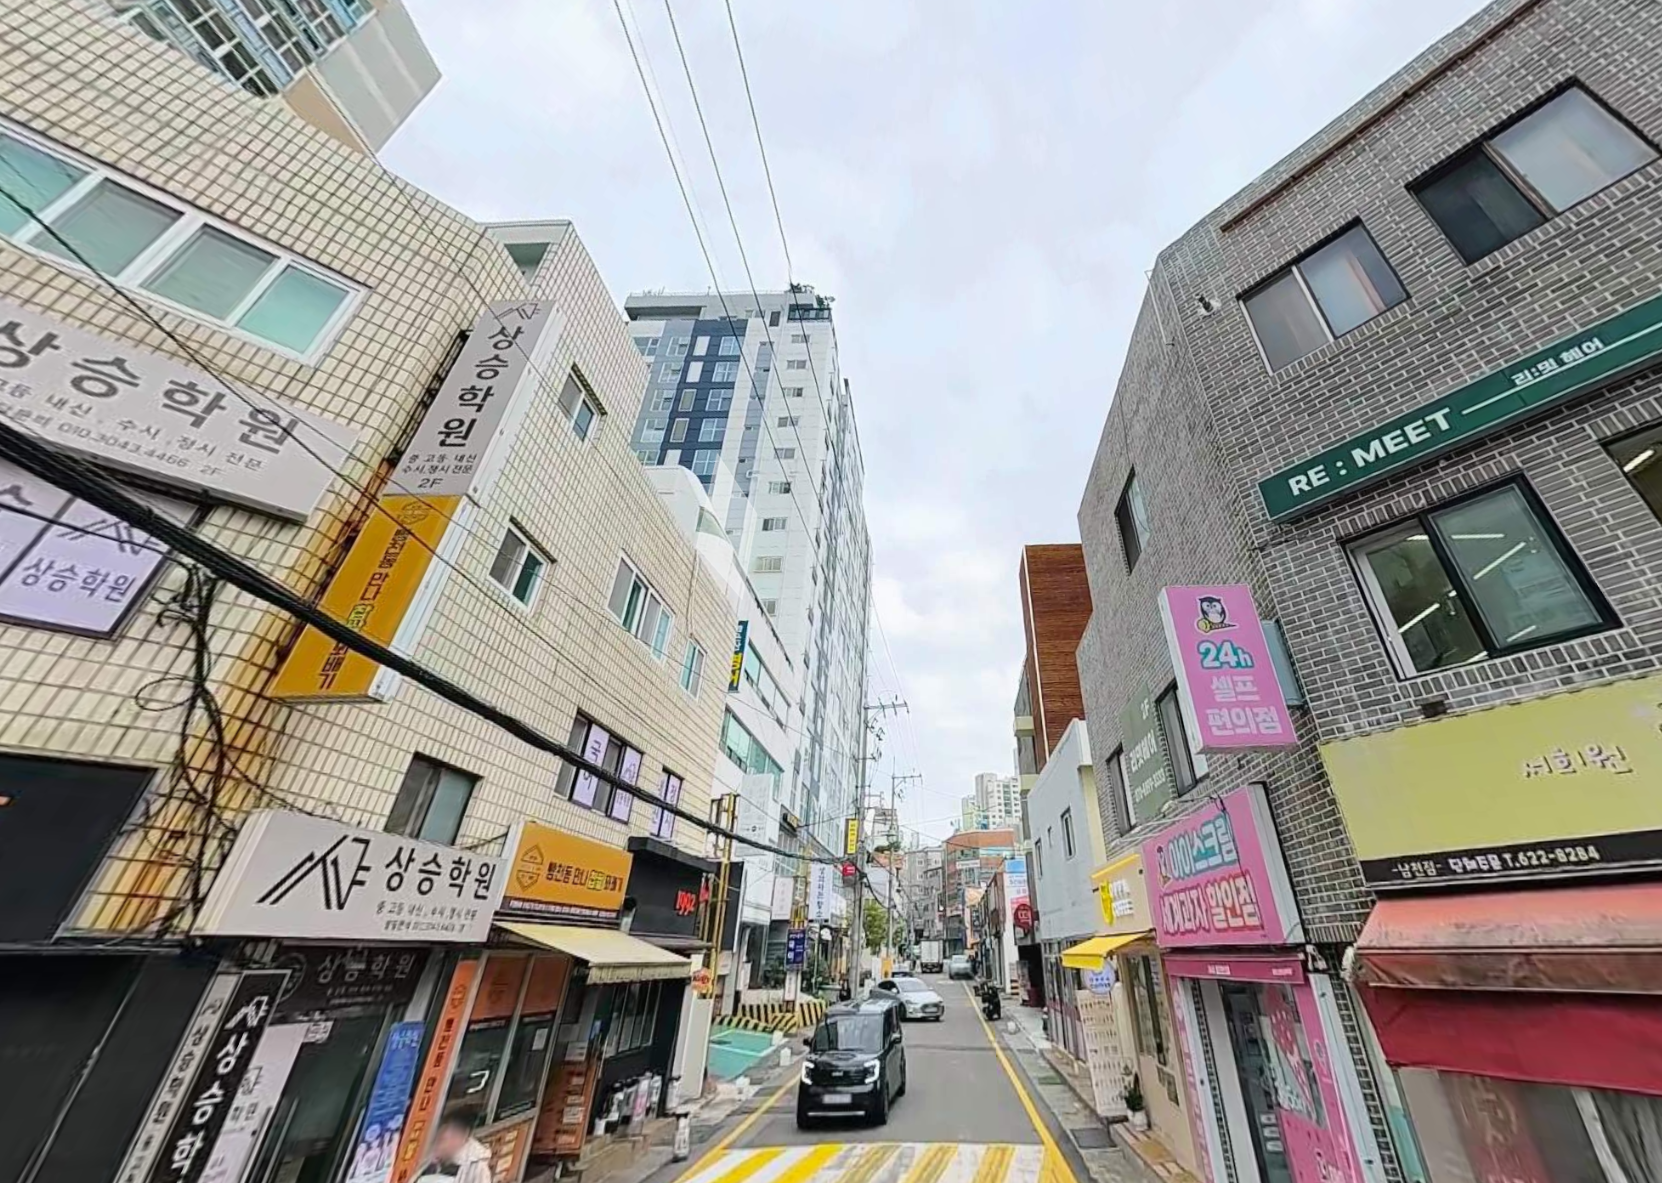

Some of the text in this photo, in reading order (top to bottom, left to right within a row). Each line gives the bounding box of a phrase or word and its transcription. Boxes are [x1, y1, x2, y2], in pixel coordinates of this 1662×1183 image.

[1559, 337, 1607, 363] 헤어
[0, 320, 299, 454] 상승학원
[438, 326, 524, 447] 상승학원
[46, 394, 93, 418] 내신
[117, 418, 161, 441] 수시
[177, 435, 217, 458] 정시
[226, 451, 263, 471] 전문
[1288, 464, 1330, 496] RE
[1350, 407, 1451, 469] MEET
[418, 478, 443, 488] 2F
[22, 557, 137, 603] 상승학원
[1197, 640, 1254, 669] 24h
[1210, 675, 1261, 702] 셀프
[1205, 706, 1283, 736] 편의점
[385, 846, 497, 901] 상승학원
[1167, 812, 1238, 881] 아이스크림
[1205, 871, 1262, 932] 할인점
